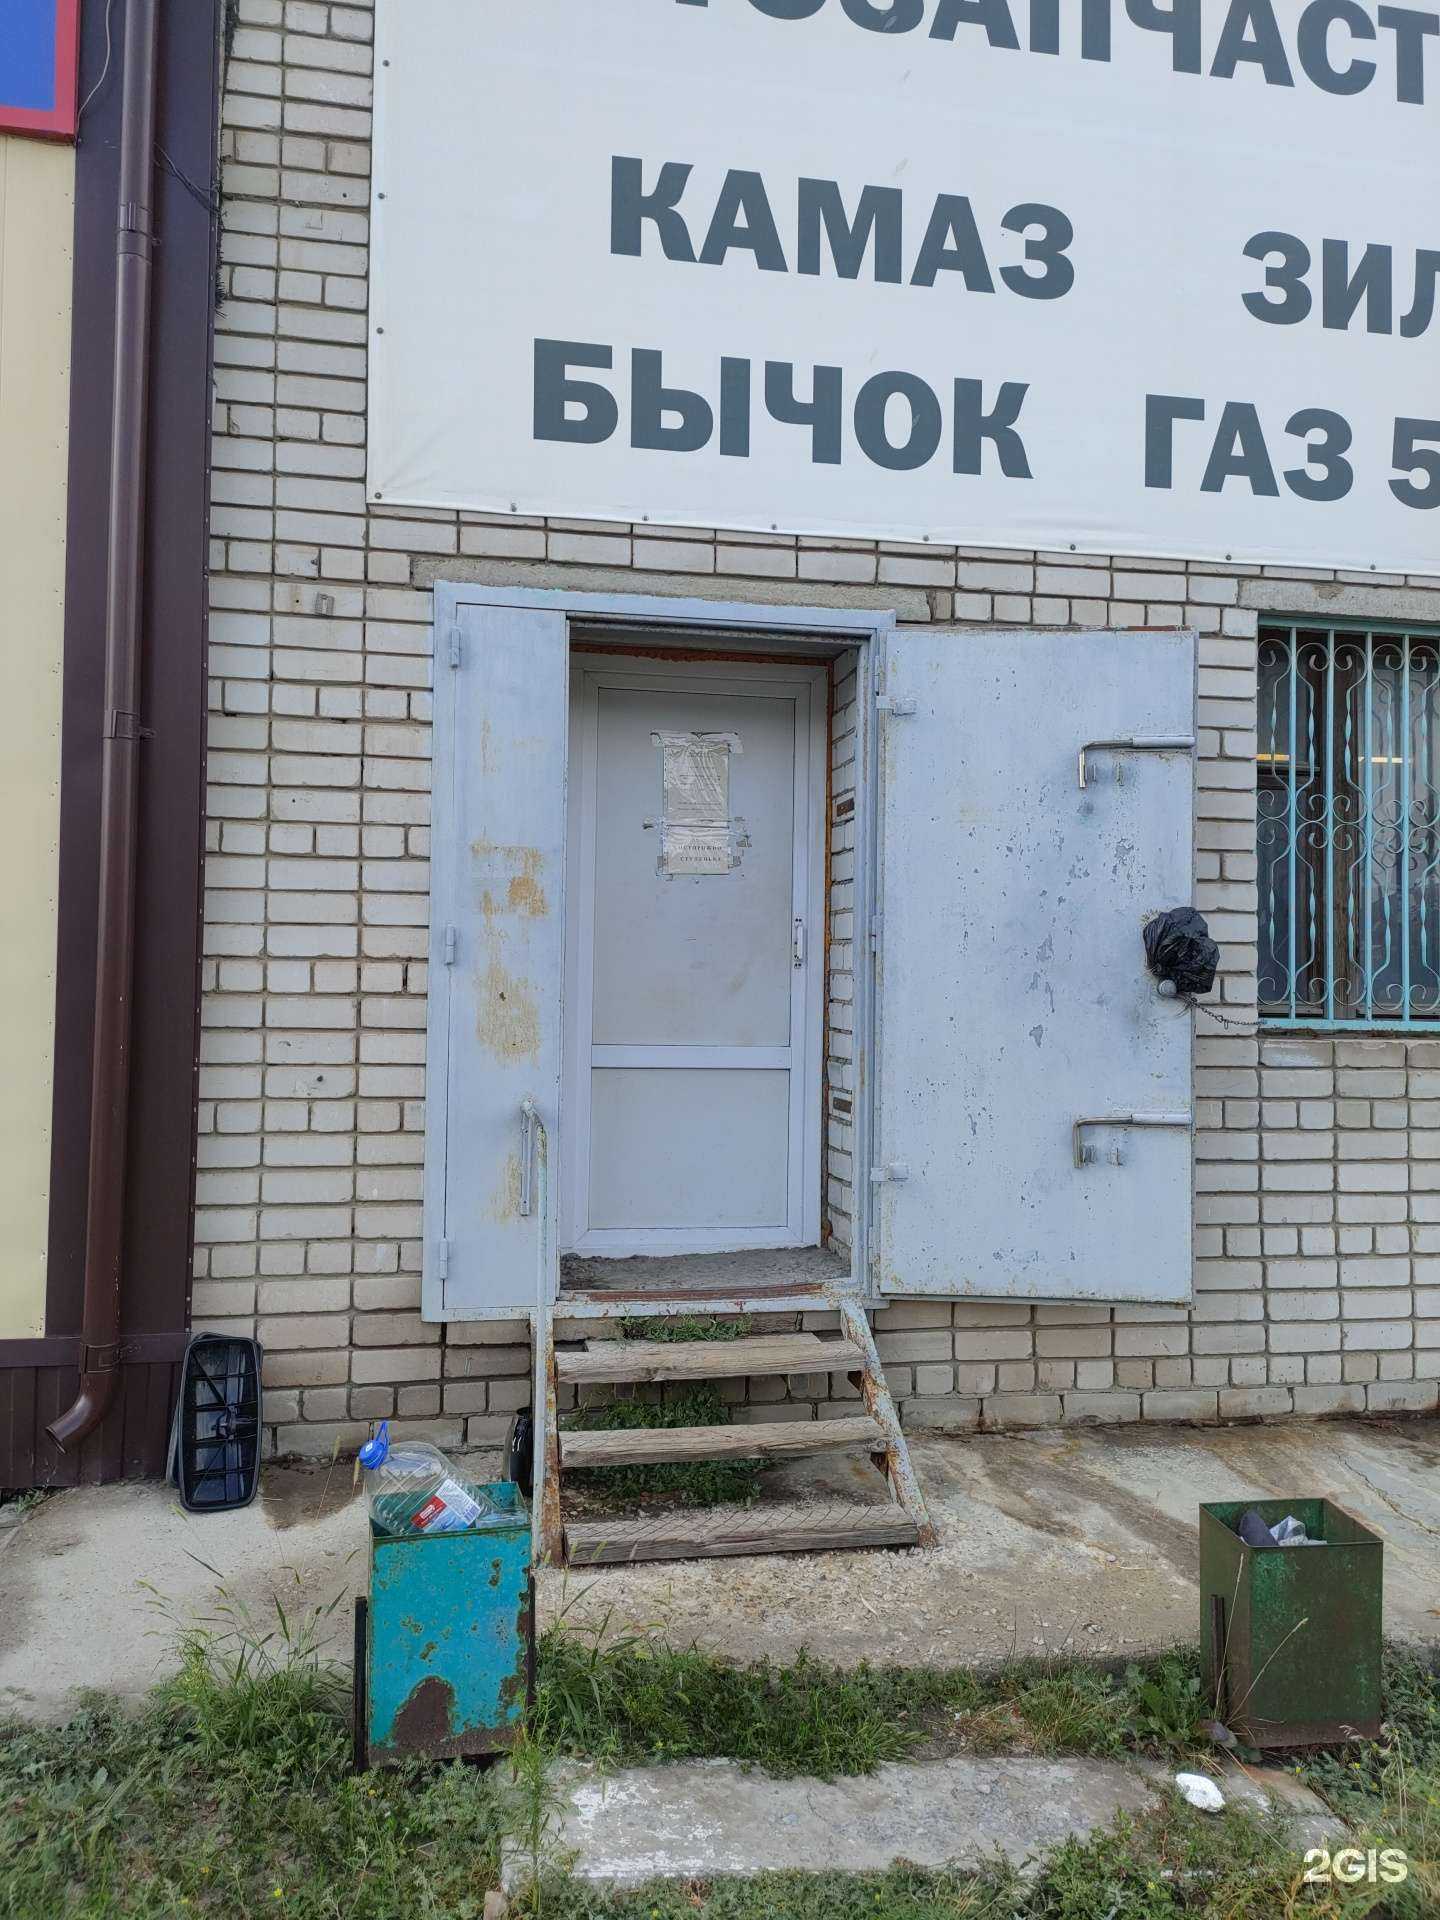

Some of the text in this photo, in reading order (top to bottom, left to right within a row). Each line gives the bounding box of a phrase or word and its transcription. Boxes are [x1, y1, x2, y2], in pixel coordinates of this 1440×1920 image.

[611, 155, 1075, 300] КАМАЗ
[533, 337, 1034, 480] БЫЧОК
[1145, 393, 1354, 502] ГАЗ
